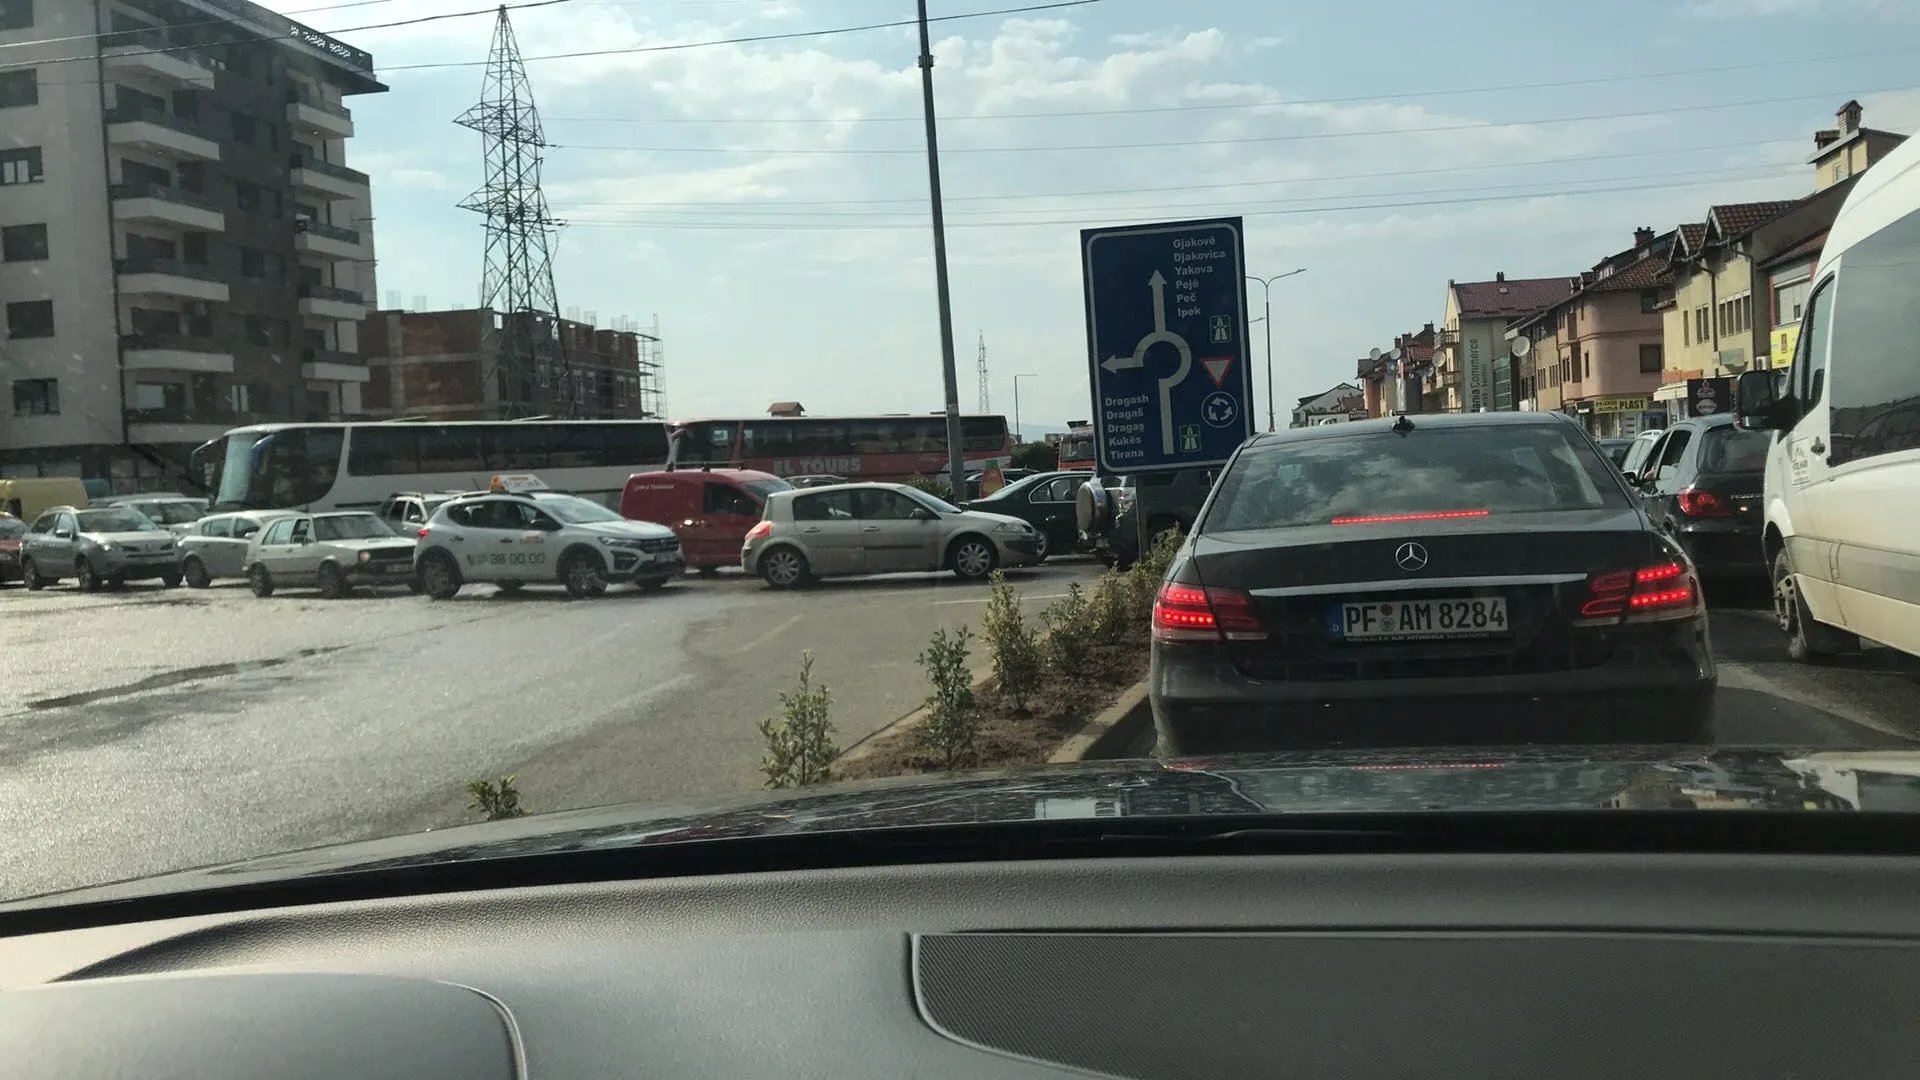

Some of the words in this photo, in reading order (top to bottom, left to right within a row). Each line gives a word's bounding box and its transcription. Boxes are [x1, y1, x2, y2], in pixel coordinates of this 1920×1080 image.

[1173, 236, 1216, 250] Gjakovë
[1174, 250, 1226, 264] Djakovica
[1175, 265, 1213, 276] Yakova
[1176, 279, 1199, 291] Pejë
[1176, 292, 1197, 303] Peč
[1177, 306, 1201, 319] Ipek
[1105, 394, 1149, 407] Dragash
[1619, 399, 1645, 410] PLAST
[1106, 407, 1144, 420] Dragaš
[1109, 435, 1142, 447] Kukës
[1110, 450, 1144, 460] Tirana
[773, 460, 794, 475] EL
[800, 457, 861, 473] TOURS
[1345, 605, 1377, 633] PF
[1399, 603, 1432, 631] AM
[1438, 600, 1505, 630] 8284
[1332, 623, 1340, 633] D
